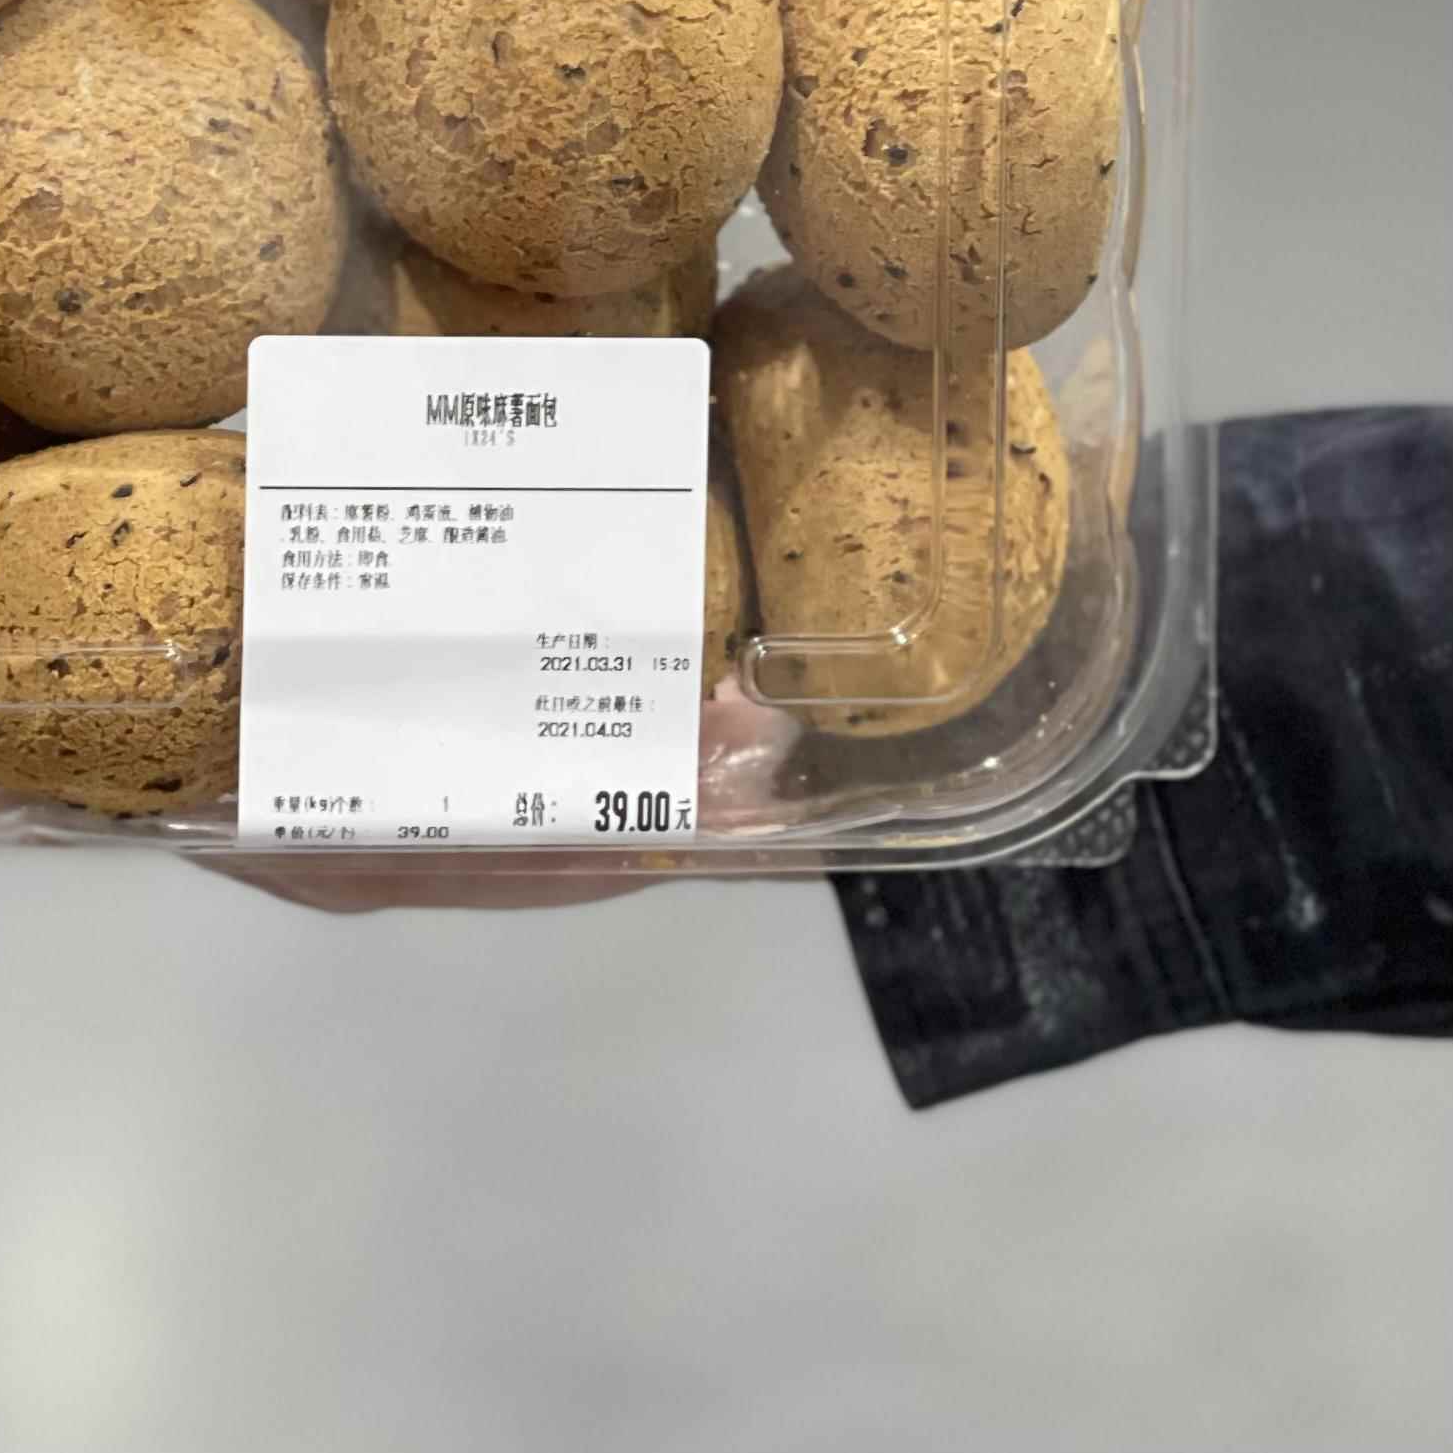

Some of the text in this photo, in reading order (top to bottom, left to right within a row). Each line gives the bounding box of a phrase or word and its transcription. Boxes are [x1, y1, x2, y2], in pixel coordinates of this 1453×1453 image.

[540, 656, 632, 671] 2021.03.31
[537, 722, 633, 738] 2021.04.03
[397, 826, 449, 839] 39.00
